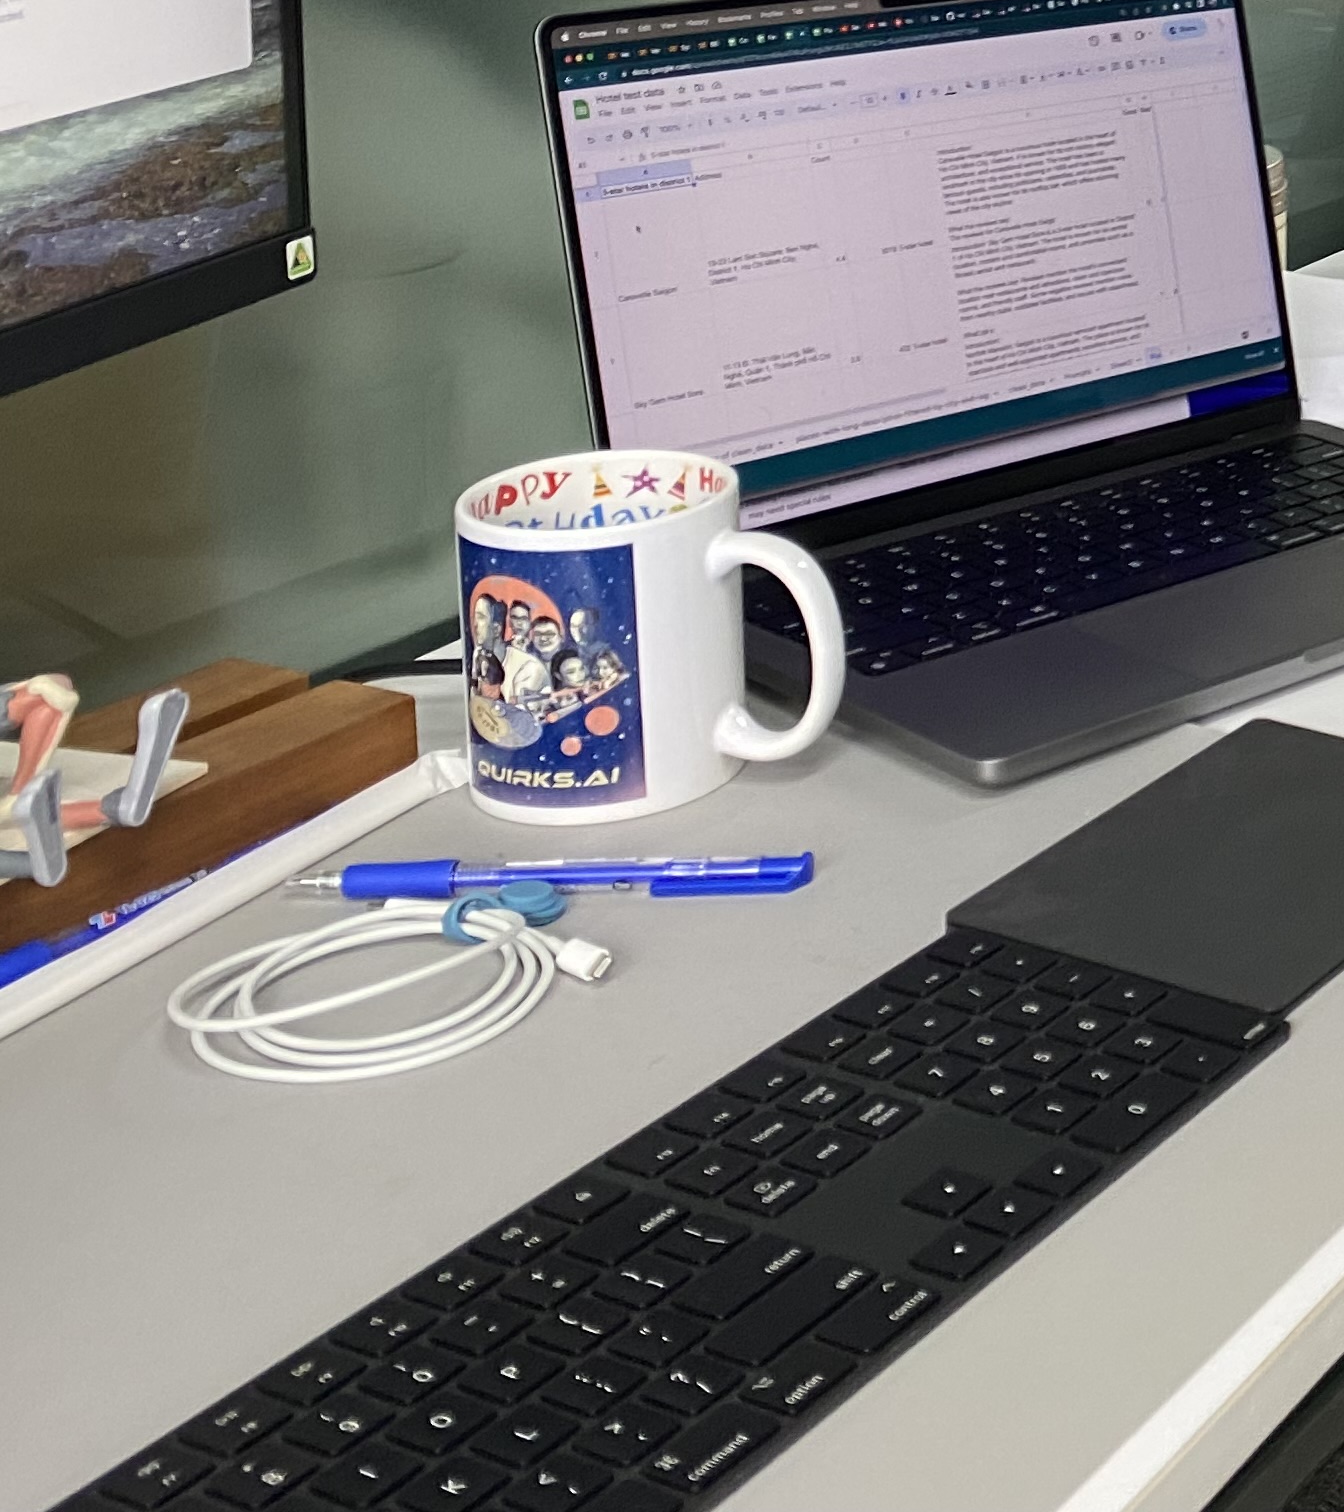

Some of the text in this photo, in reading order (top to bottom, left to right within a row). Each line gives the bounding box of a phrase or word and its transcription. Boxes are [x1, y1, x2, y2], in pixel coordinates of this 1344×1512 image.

[594, 87, 665, 104] Hotel test data
[469, 471, 572, 521] appy
[476, 759, 621, 789] QUIRKS.AI
[1021, 1003, 1040, 1014] 9
[1078, 1020, 1096, 1031] 6
[976, 1035, 995, 1046] 8
[1134, 1037, 1153, 1047] 3
[1033, 1052, 1052, 1063] 5
[927, 1067, 944, 1078] 7
[1090, 1069, 1110, 1081] 2
[800, 1085, 828, 1104] page
[989, 1085, 1005, 1096] 4
[1046, 1104, 1063, 1113] 1
[1127, 1103, 1147, 1115] 0
[750, 1122, 784, 1143] home
[816, 1143, 839, 1160] end
[703, 1165, 721, 1176] fn
[761, 1180, 796, 1204] delete
[640, 1207, 676, 1233] delete
[764, 1248, 801, 1274] return
[835, 1269, 864, 1290] shift
[888, 1290, 928, 1321] control
[500, 1364, 520, 1380] P
[784, 1374, 824, 1405] option
[514, 1430, 539, 1441] L
[687, 1433, 750, 1482] command
[440, 1479, 467, 1495] K
